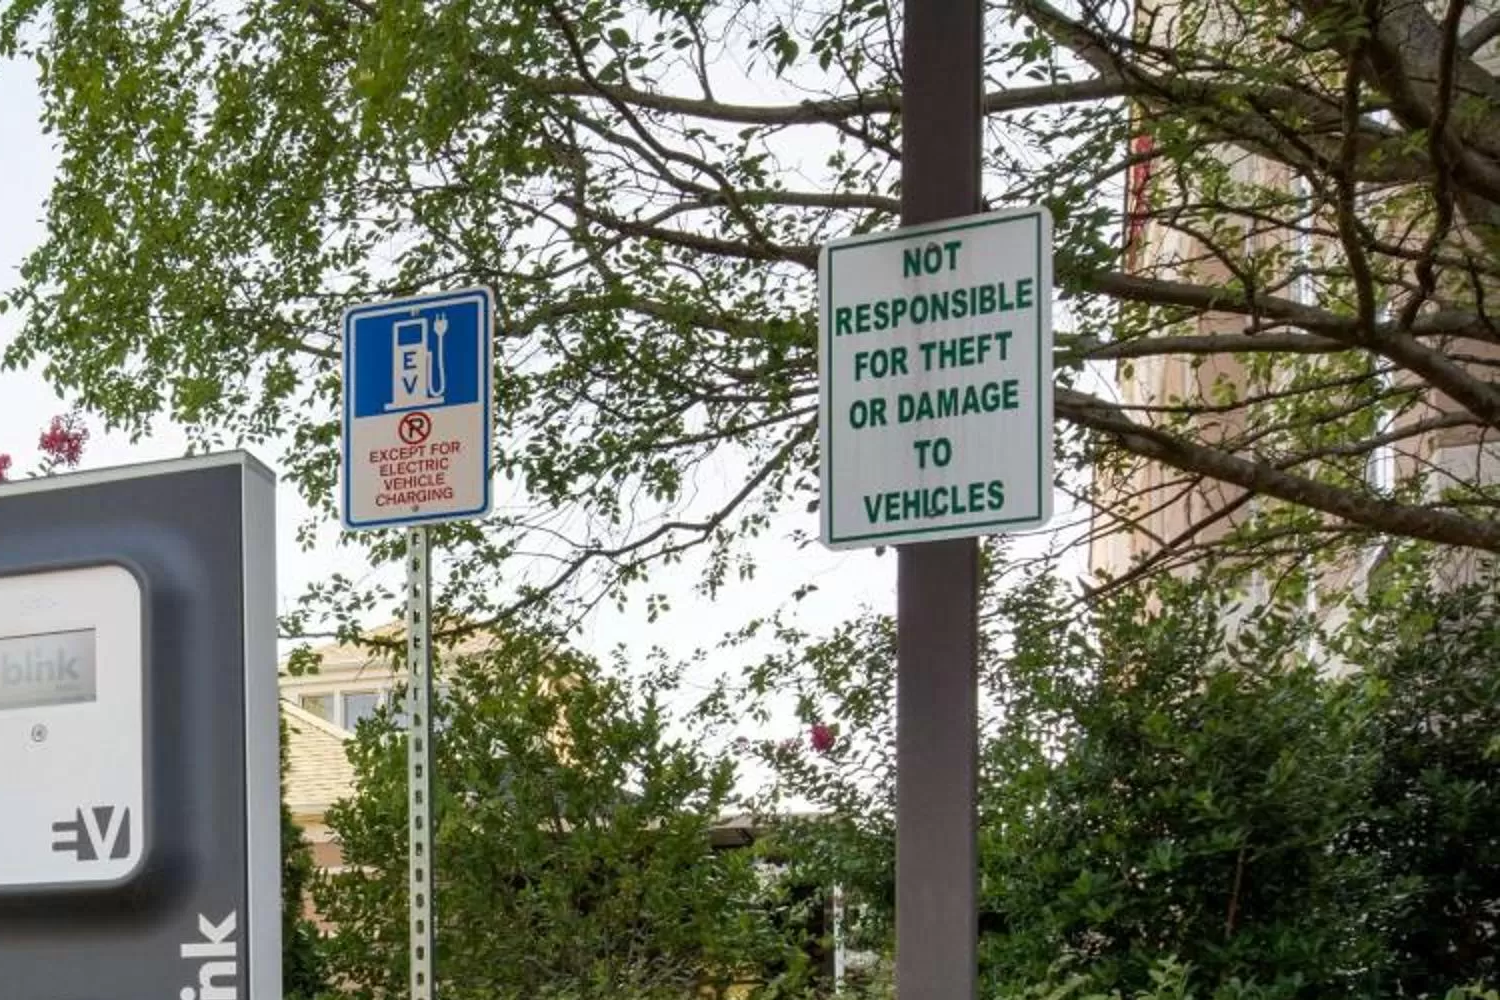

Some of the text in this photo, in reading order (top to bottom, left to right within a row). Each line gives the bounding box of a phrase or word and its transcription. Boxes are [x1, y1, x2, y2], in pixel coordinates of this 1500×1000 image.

[903, 241, 961, 278] NOT
[835, 278, 1033, 336] RESPONSIBLE
[855, 331, 1013, 381] FOR THEFT
[850, 379, 1019, 429] OR DAMAGE
[369, 441, 461, 463] EXCEPT FOR
[379, 457, 449, 477] ELECTRIC
[913, 437, 952, 469] TO
[375, 487, 453, 507] CHARGING
[383, 473, 445, 491] VEHICLE
[863, 480, 1005, 524] VEHICLES
[3, 643, 82, 686] blink
